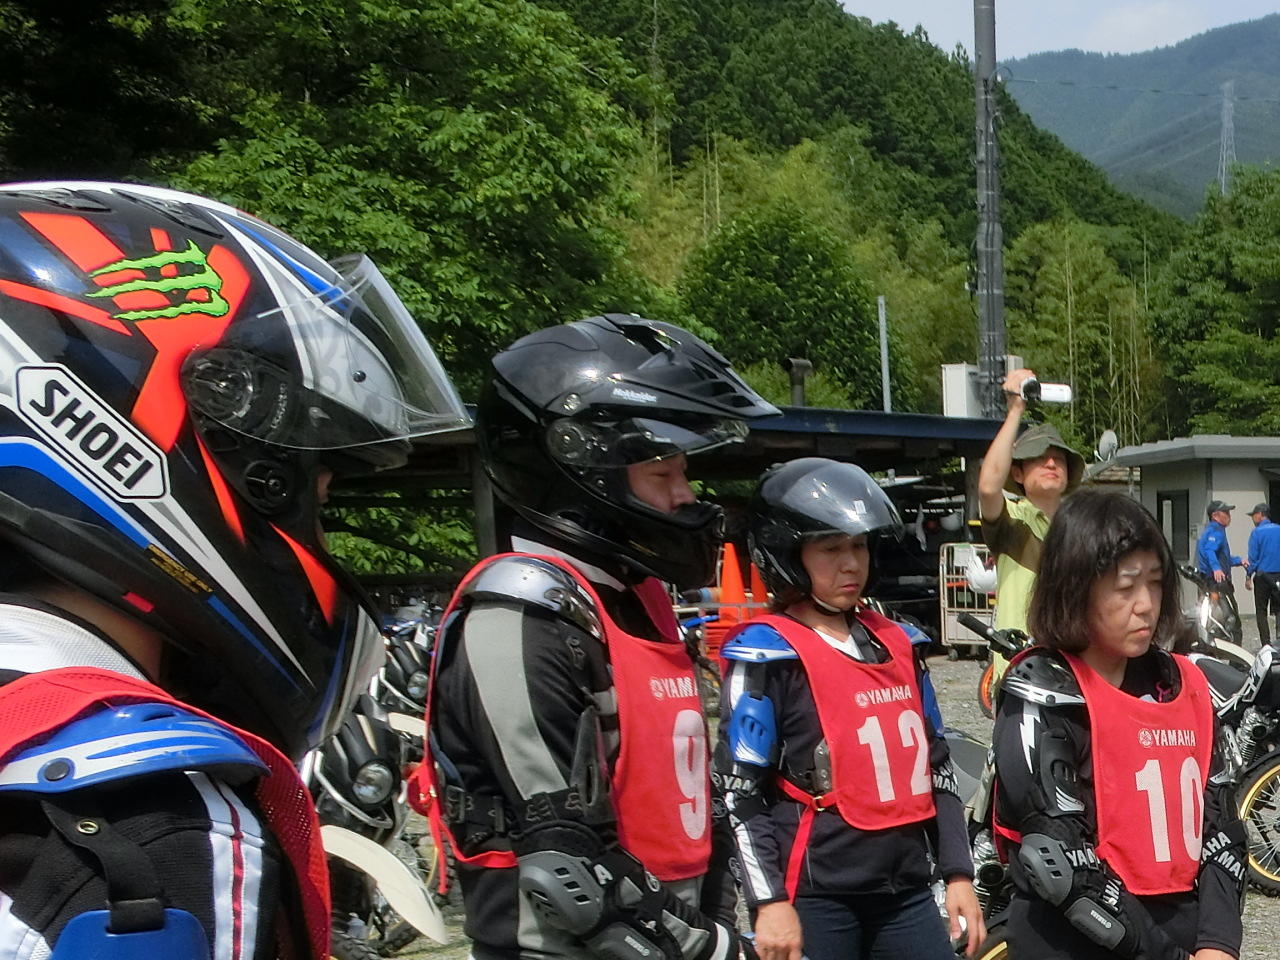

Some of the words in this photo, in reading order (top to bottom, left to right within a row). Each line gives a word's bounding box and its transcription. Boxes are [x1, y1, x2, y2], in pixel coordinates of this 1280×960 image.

[29, 379, 154, 490] SHOEI
[867, 684, 912, 705] YAMAHA
[1152, 730, 1196, 746] YAMAHA
[673, 709, 706, 840] 9
[856, 710, 931, 803] 12
[1135, 756, 1205, 862] 10
